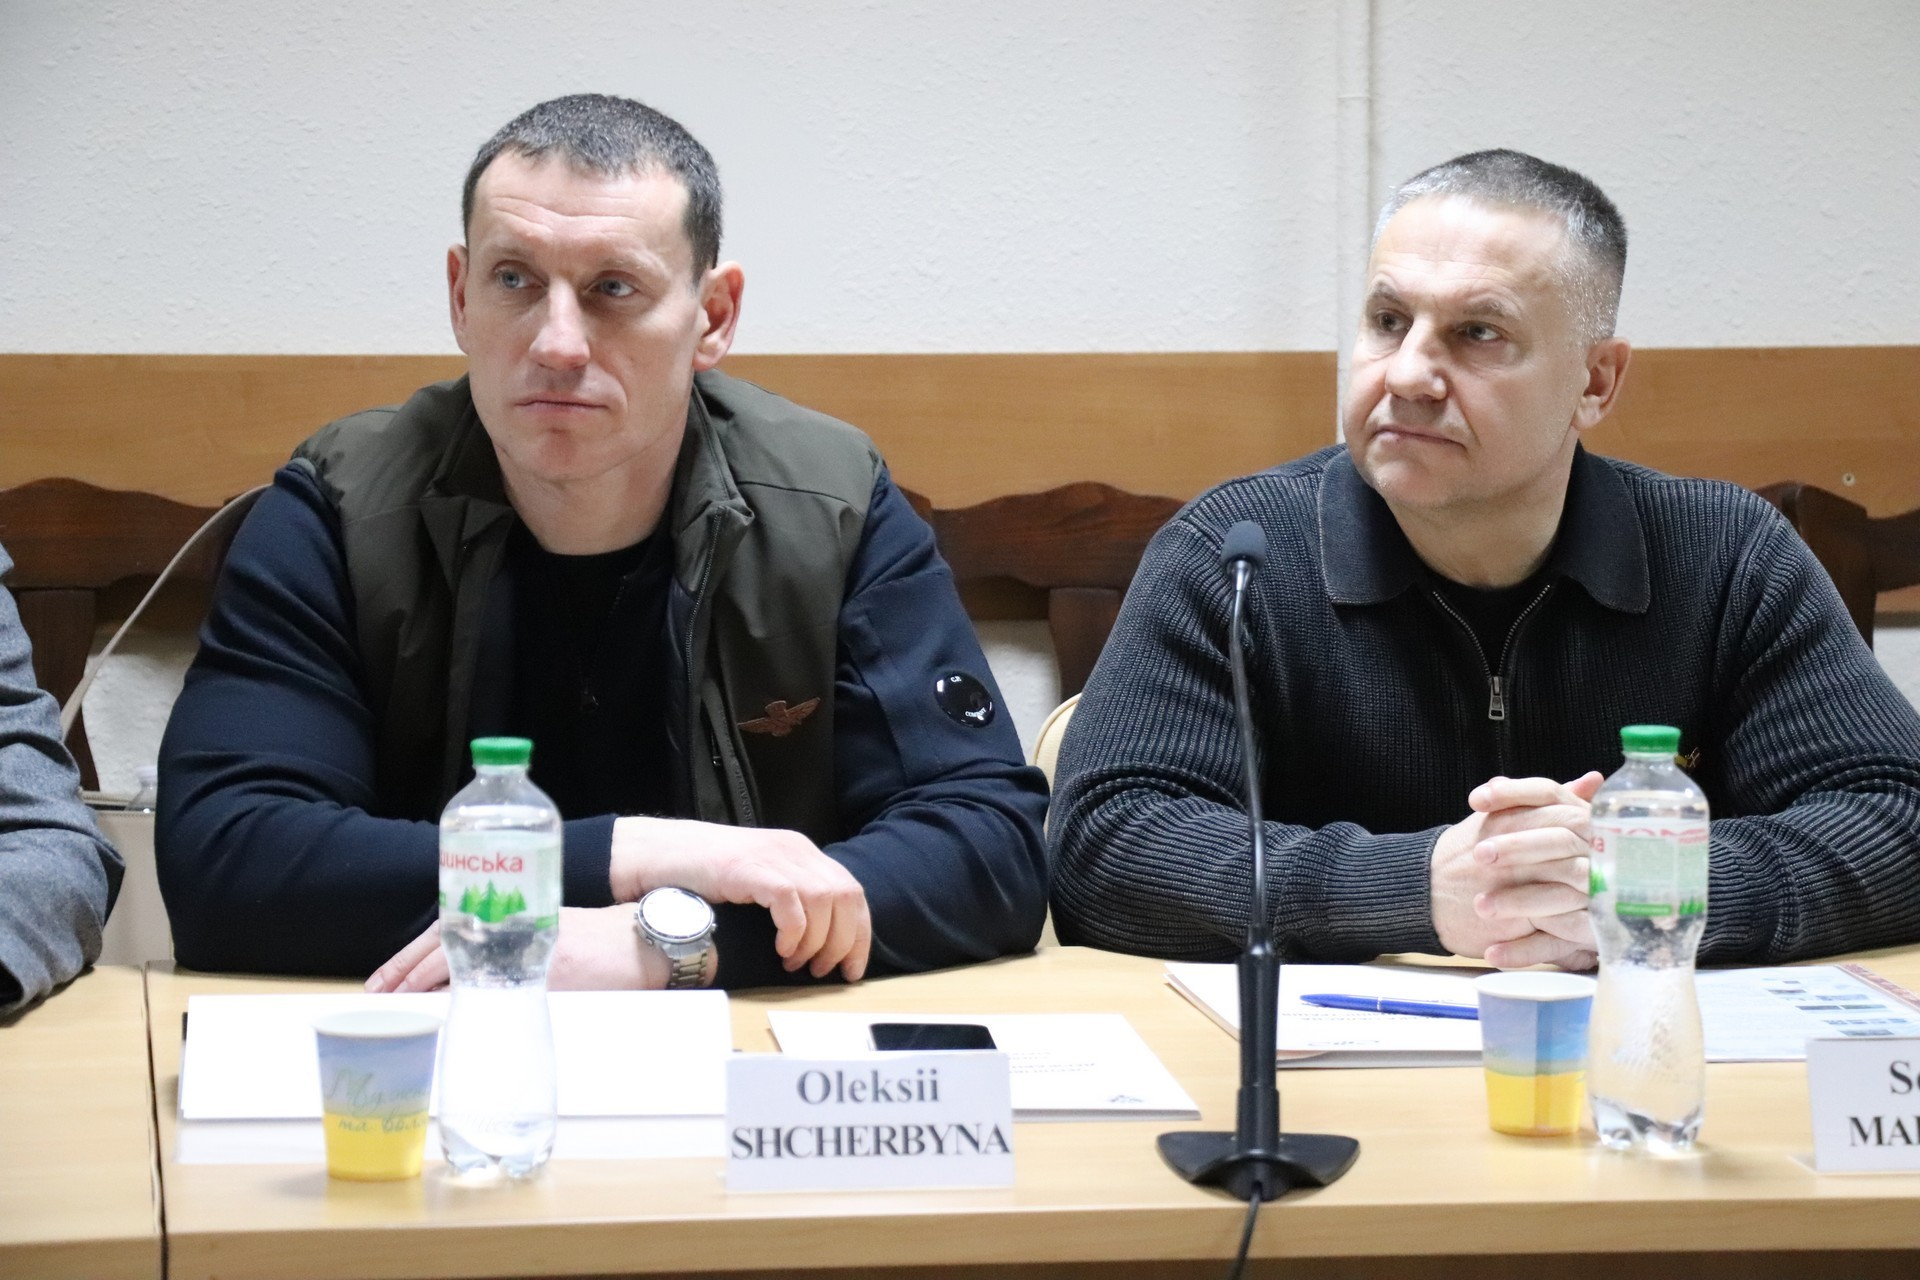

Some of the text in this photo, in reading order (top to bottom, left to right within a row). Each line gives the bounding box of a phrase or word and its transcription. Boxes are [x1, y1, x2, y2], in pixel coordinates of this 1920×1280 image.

[796, 1068, 939, 1105] Oleksii
[1889, 1059, 1920, 1095] S
[730, 1123, 1012, 1160] SHCHERBYNA
